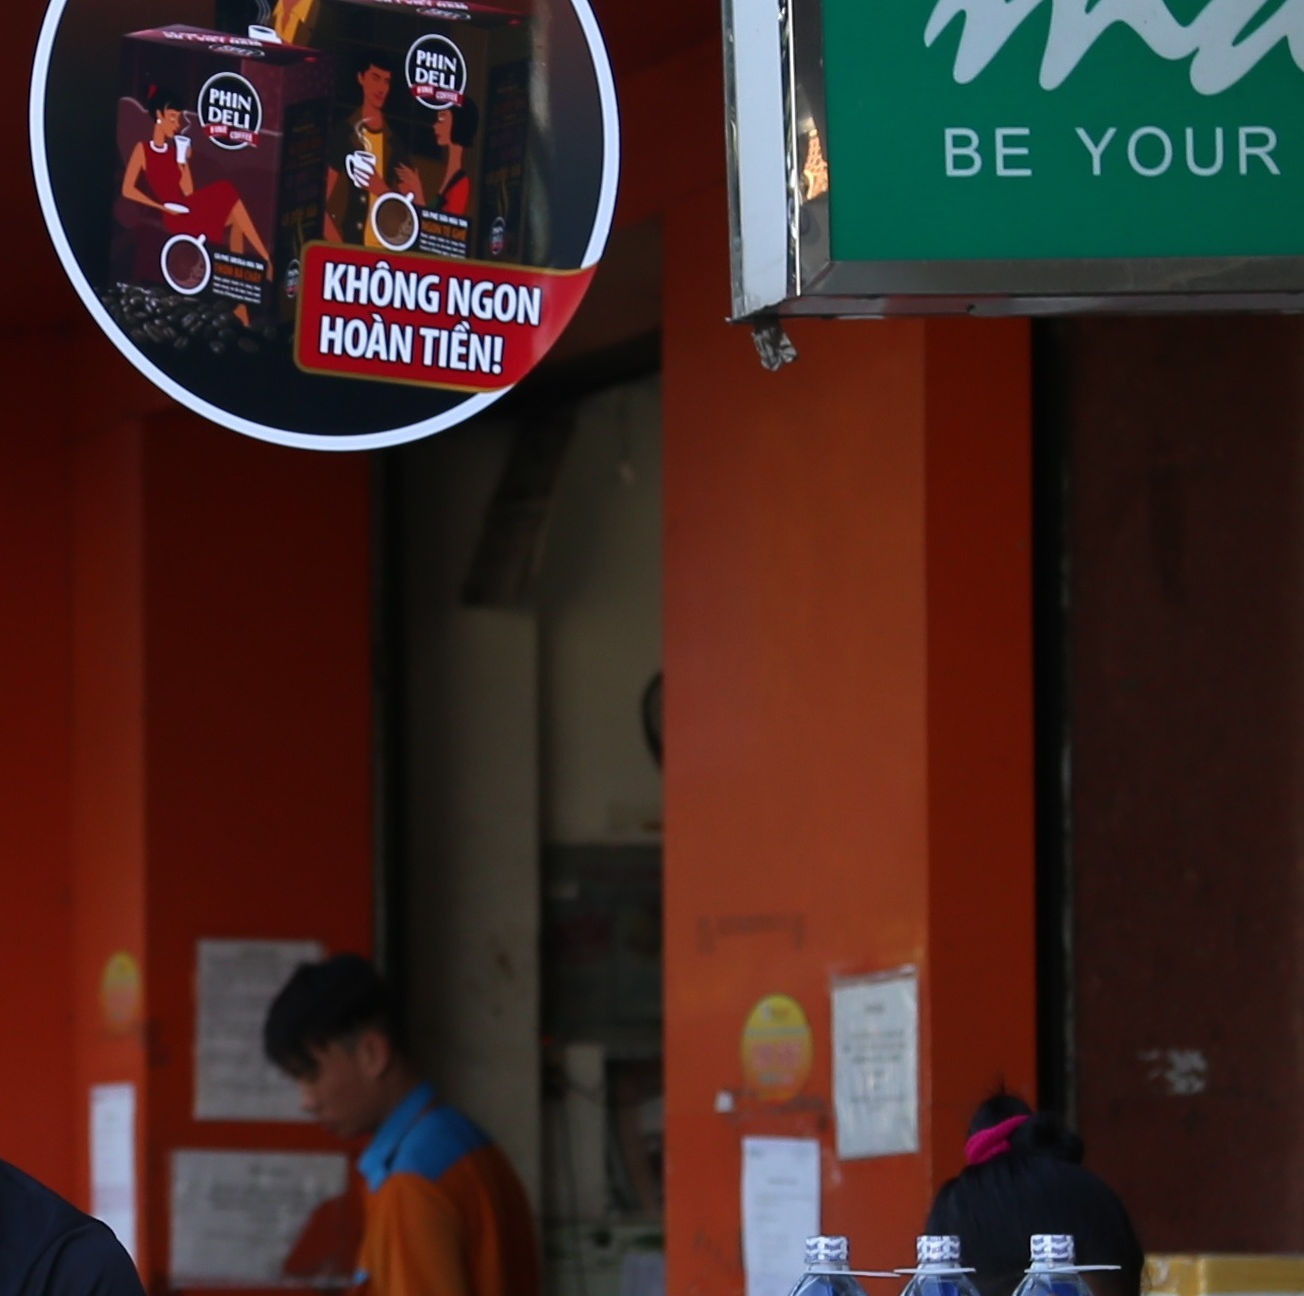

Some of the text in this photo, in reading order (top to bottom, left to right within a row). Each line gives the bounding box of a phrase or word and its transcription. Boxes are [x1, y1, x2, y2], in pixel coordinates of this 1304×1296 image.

[416, 49, 457, 73] PHIN
[414, 67, 456, 91] DELI
[209, 87, 252, 112] PHIN
[208, 105, 250, 130] DELI
[943, 125, 1281, 178] BE YOUR
[322, 260, 441, 314] KHÔNG
[446, 276, 541, 326] NGON
[318, 313, 504, 375] HOÀN TIỀN!
